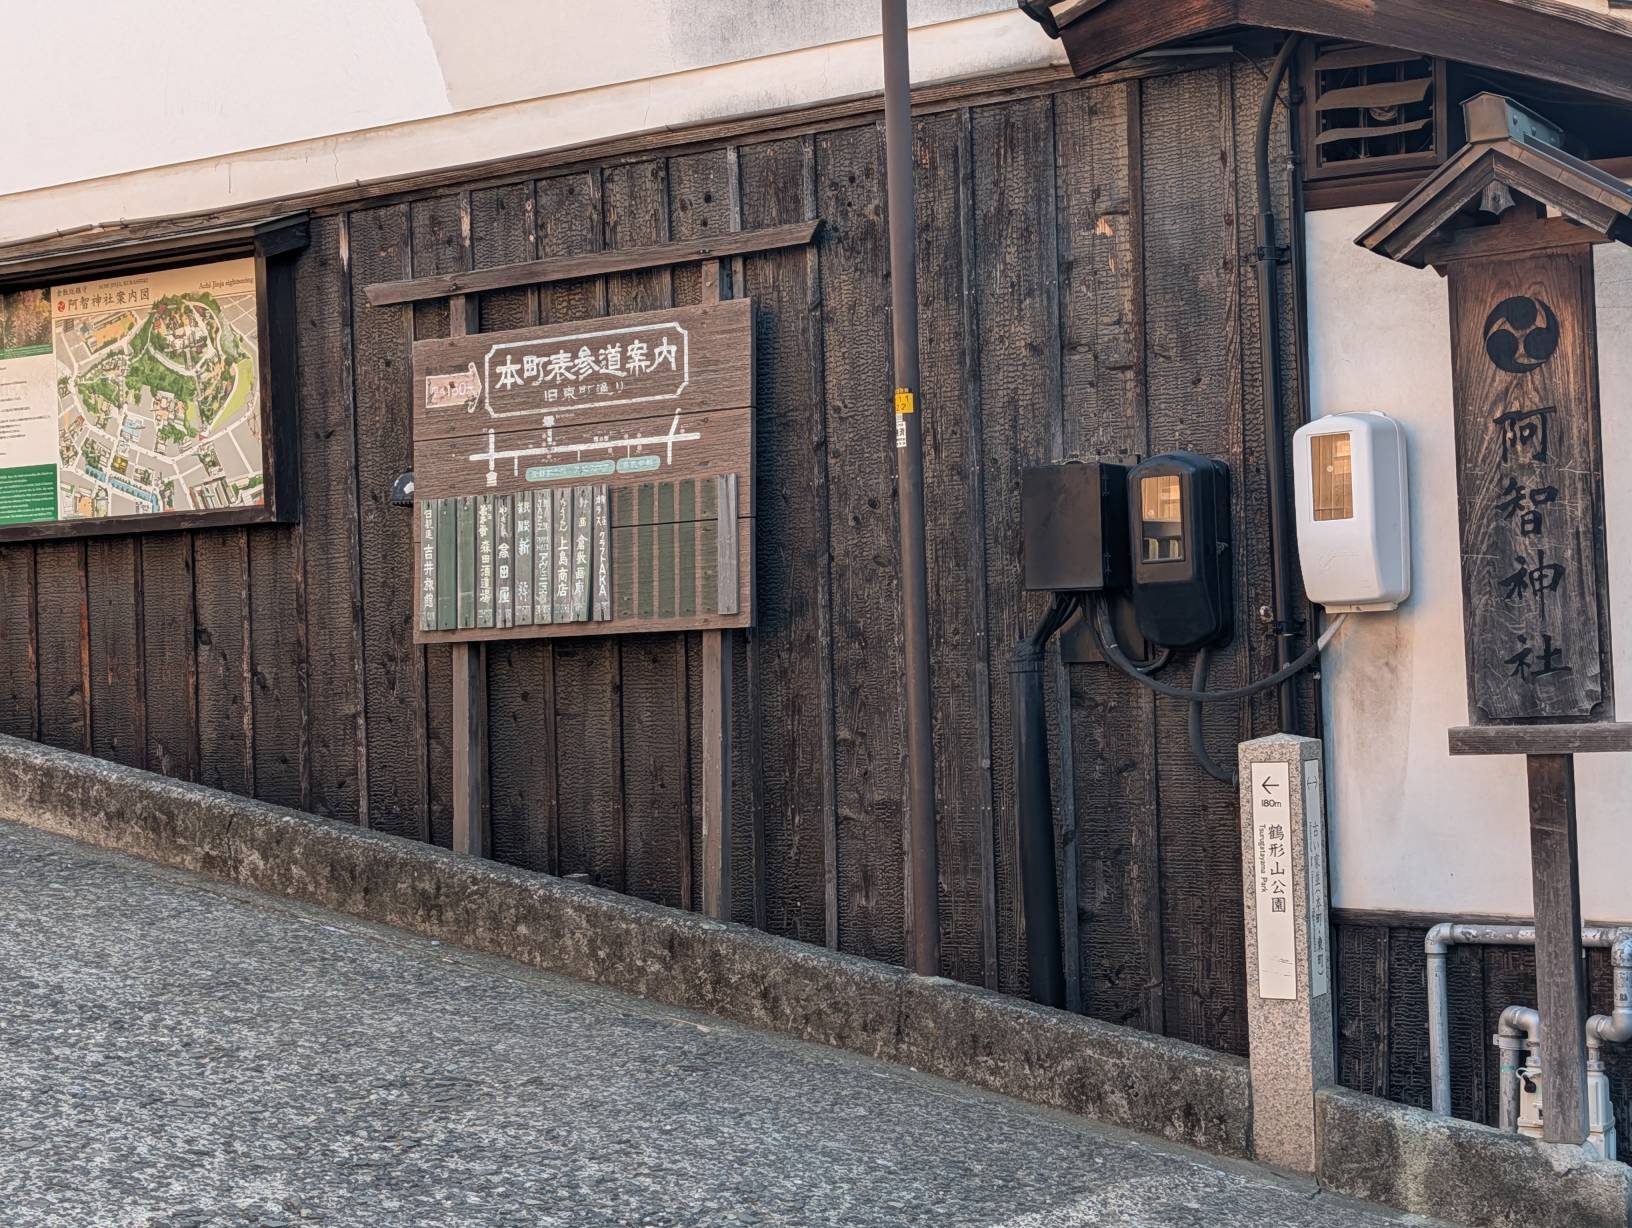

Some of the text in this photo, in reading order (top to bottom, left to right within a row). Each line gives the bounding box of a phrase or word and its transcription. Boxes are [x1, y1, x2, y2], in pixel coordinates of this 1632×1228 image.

[68, 288, 150, 312] 阿智神社案内図
[494, 337, 679, 390] 本町表参道案内
[543, 380, 625, 402] 旧東町通り
[557, 535, 569, 598] 上島商店
[1492, 405, 1572, 679] 阿智神社
[423, 544, 435, 608] 吉井旅館
[1261, 798, 1282, 808] 180m
[1260, 876, 1268, 893] Park
[1267, 823, 1286, 913] 鶴形山公園
